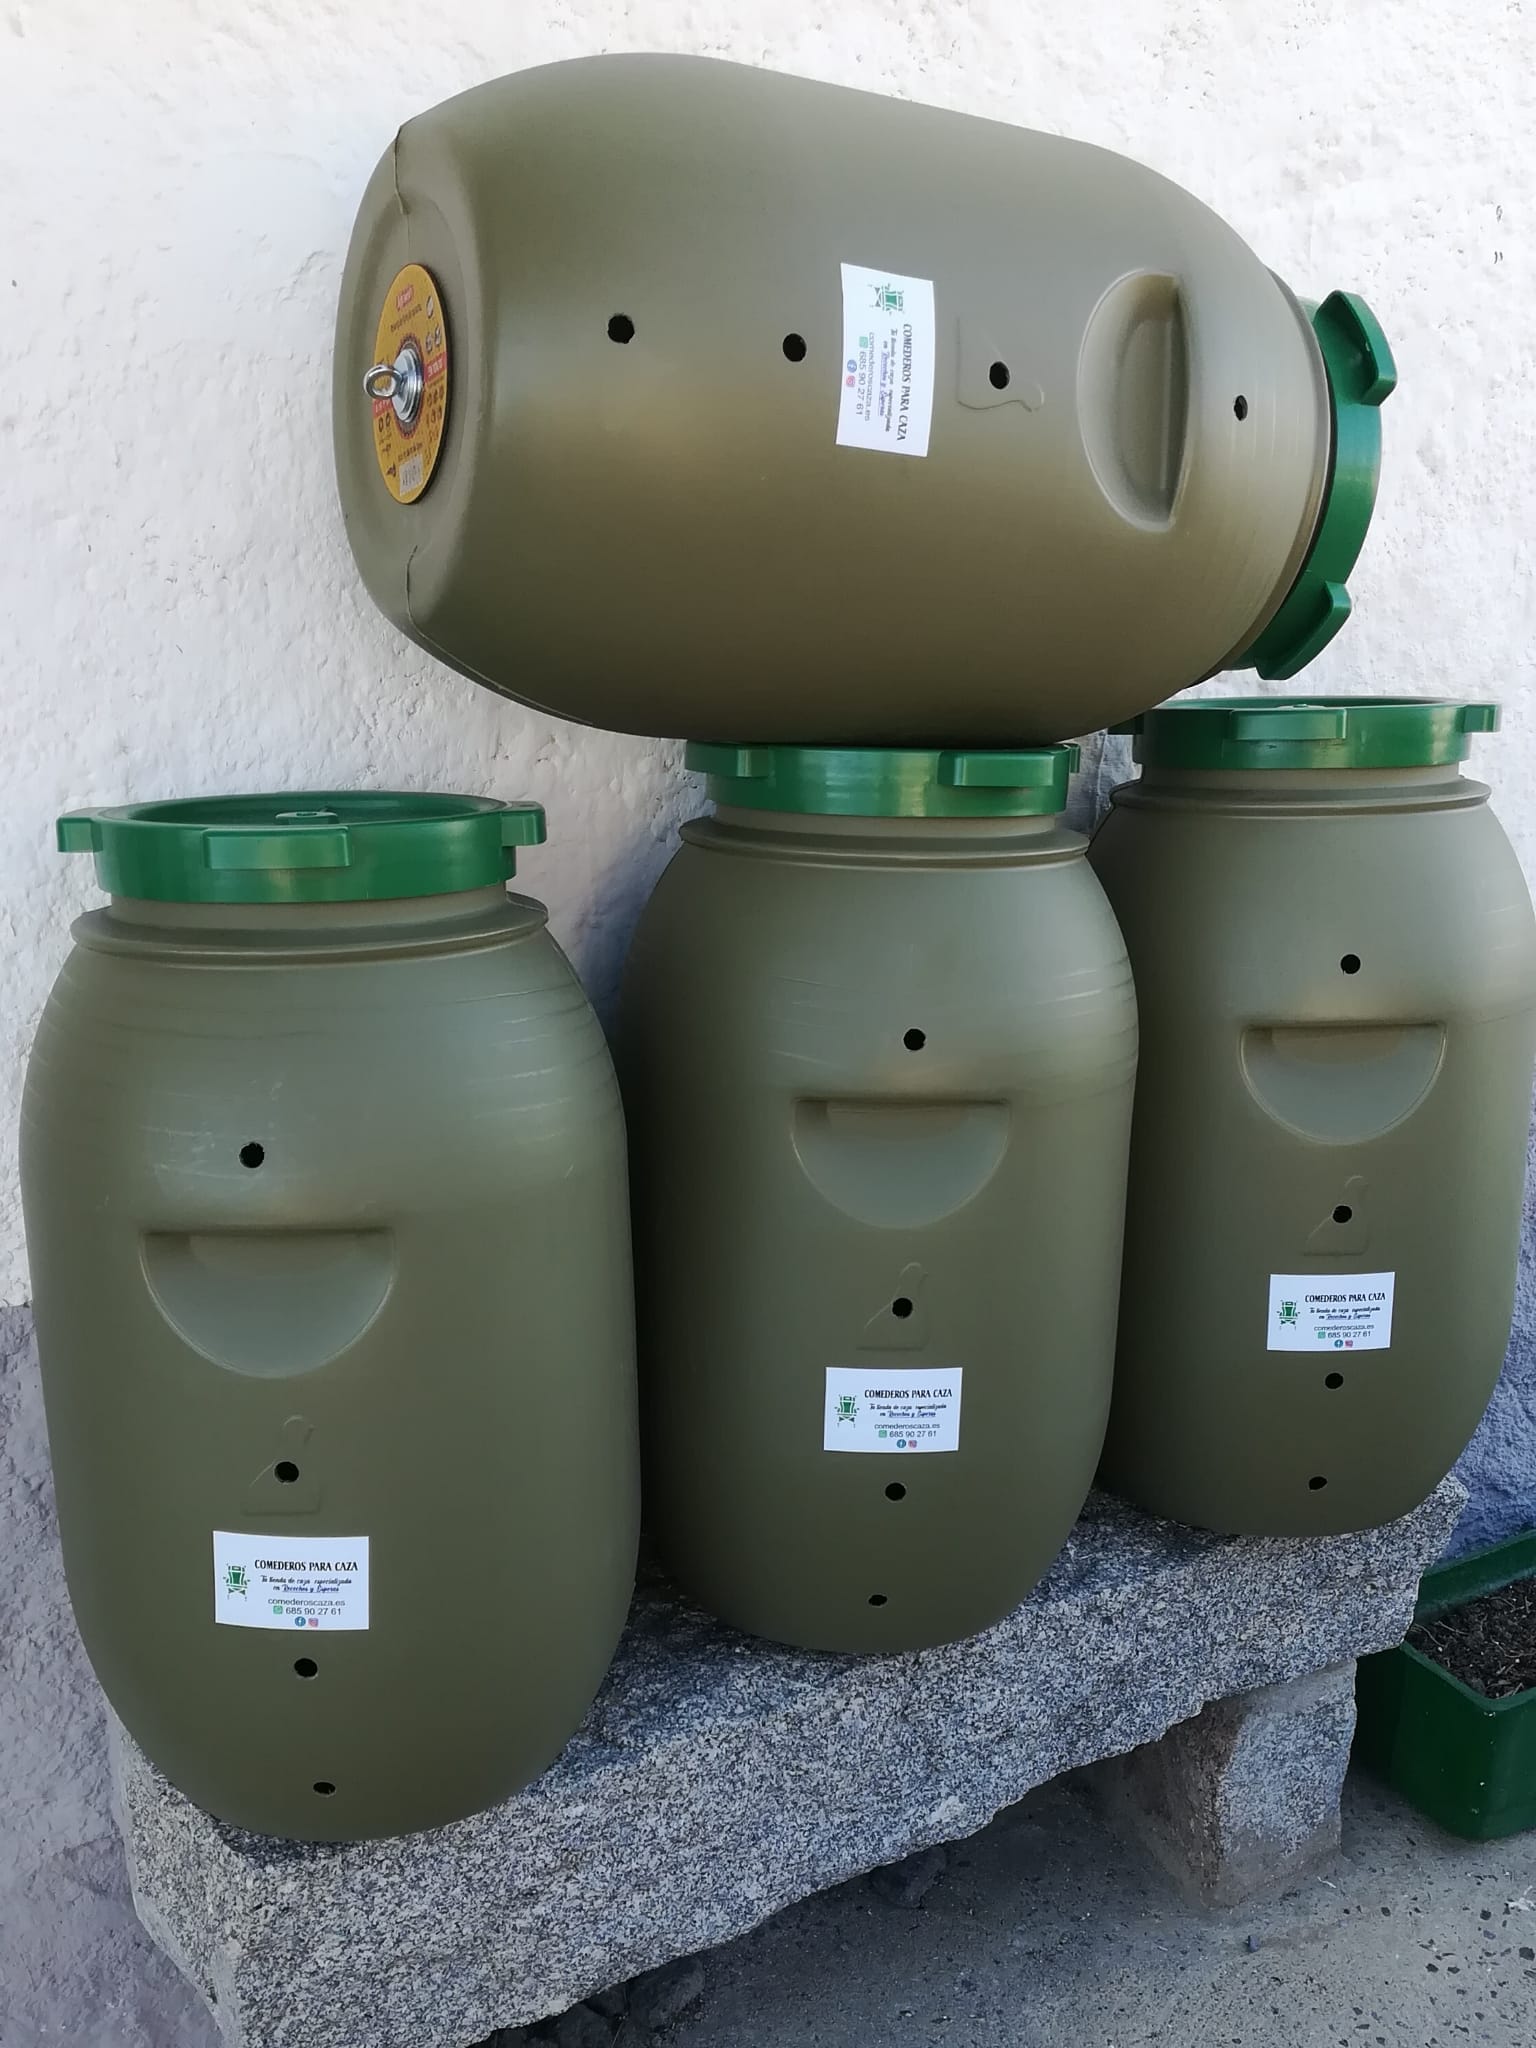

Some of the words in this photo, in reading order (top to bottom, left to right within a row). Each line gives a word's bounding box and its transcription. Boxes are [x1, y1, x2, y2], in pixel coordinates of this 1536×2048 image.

[902, 324, 912, 382] COMEDEROS
[891, 359, 896, 367] de
[858, 373, 866, 385] 90
[865, 332, 875, 421] comederoscaza.es
[857, 388, 865, 400] 27
[900, 386, 910, 411] PARA
[856, 403, 863, 415] 61
[897, 415, 908, 441] CAZA
[1349, 1294, 1366, 1302] PARA
[1369, 1293, 1385, 1301] CAZA
[865, 1390, 909, 1398] COMEDEROS
[912, 1390, 931, 1398] PARA
[933, 1389, 952, 1397] CAZA
[255, 1560, 306, 1571] COMEDEROS
[309, 1562, 331, 1571] PARA
[335, 1562, 358, 1571] CAZA
